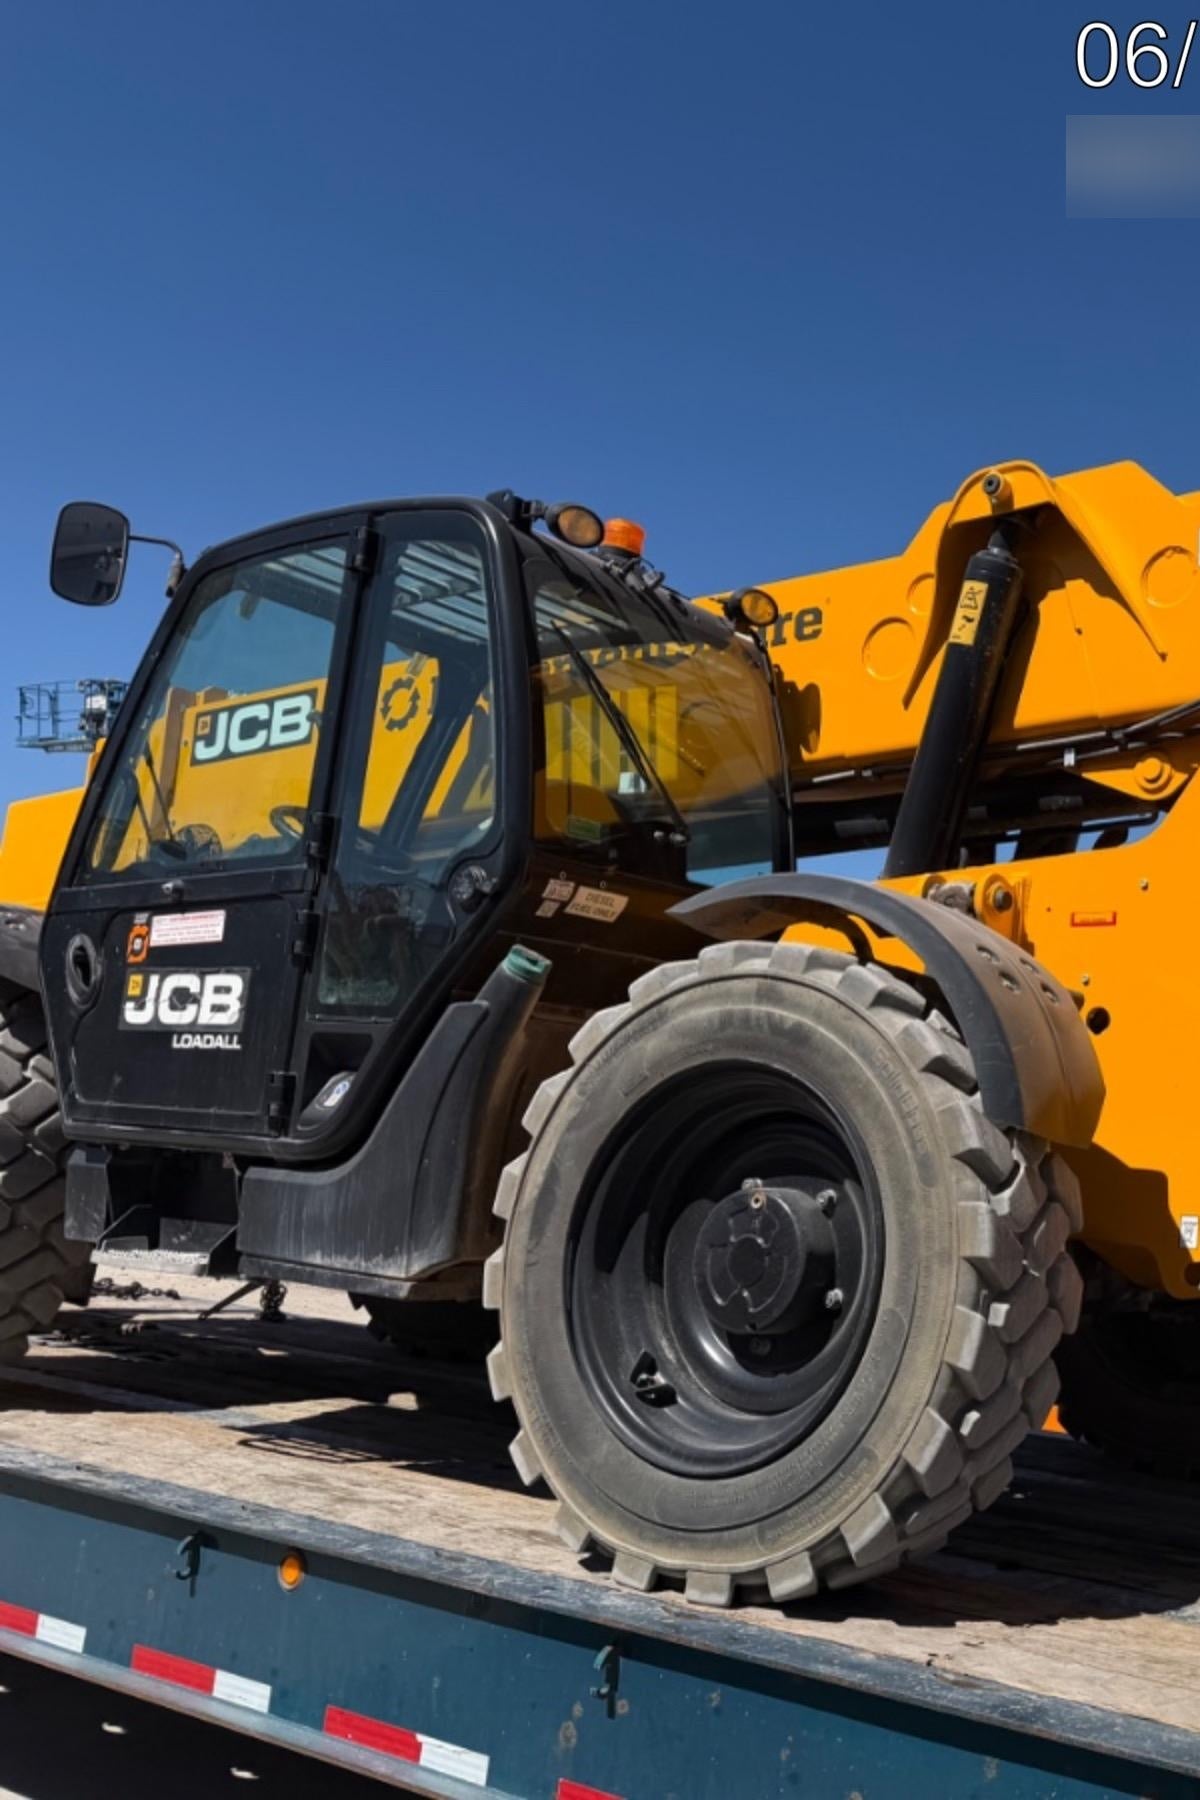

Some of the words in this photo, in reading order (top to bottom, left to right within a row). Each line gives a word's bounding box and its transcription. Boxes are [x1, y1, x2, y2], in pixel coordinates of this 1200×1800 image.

[194, 694, 313, 761] JCB
[123, 973, 243, 1025] JCB
[172, 1033, 241, 1049] LOADALL
